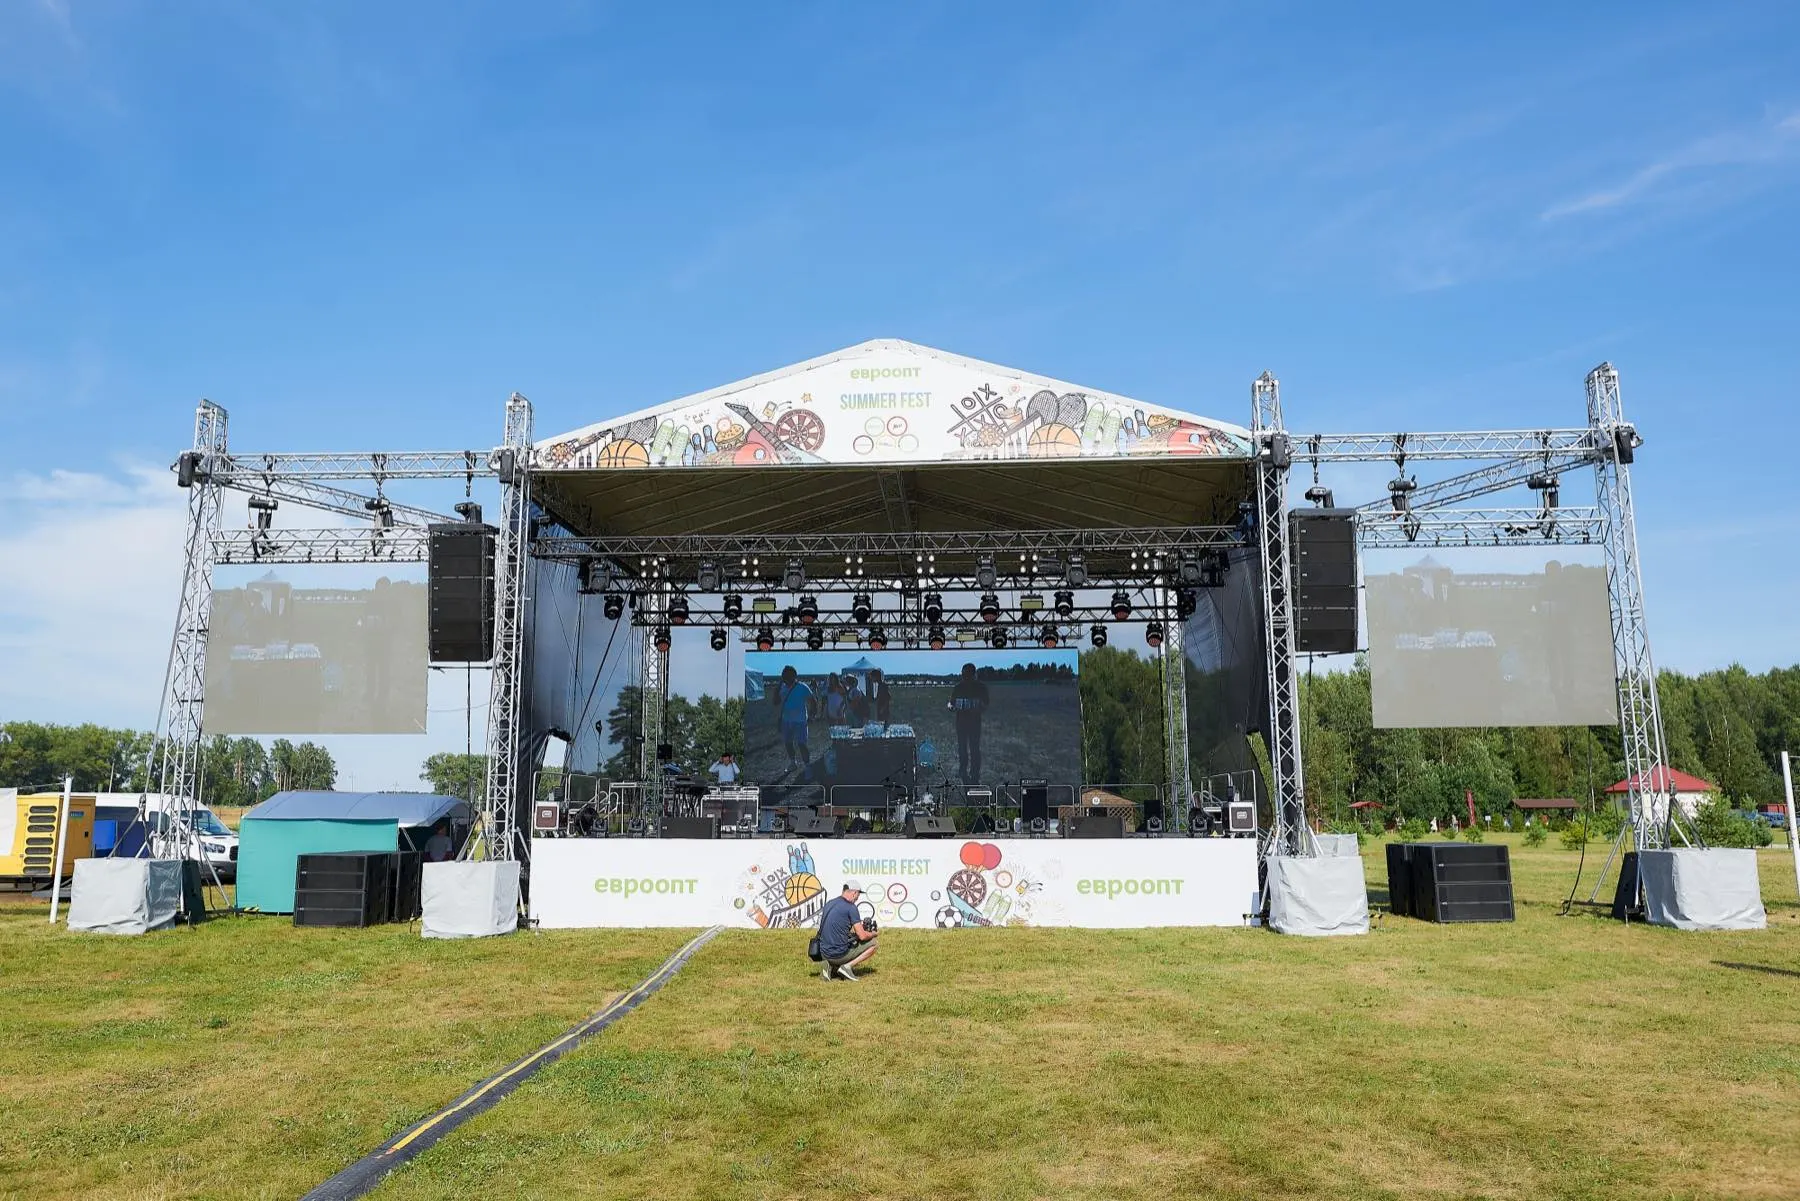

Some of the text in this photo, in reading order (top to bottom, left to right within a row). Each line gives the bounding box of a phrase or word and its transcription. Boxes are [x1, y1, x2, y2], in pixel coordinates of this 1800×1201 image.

[850, 366, 921, 381] евроопт
[840, 391, 931, 410] SUMMER FEST
[842, 857, 931, 875] SUMMER FEST
[594, 877, 698, 898] евроопт
[1076, 878, 1184, 900] евроопт
